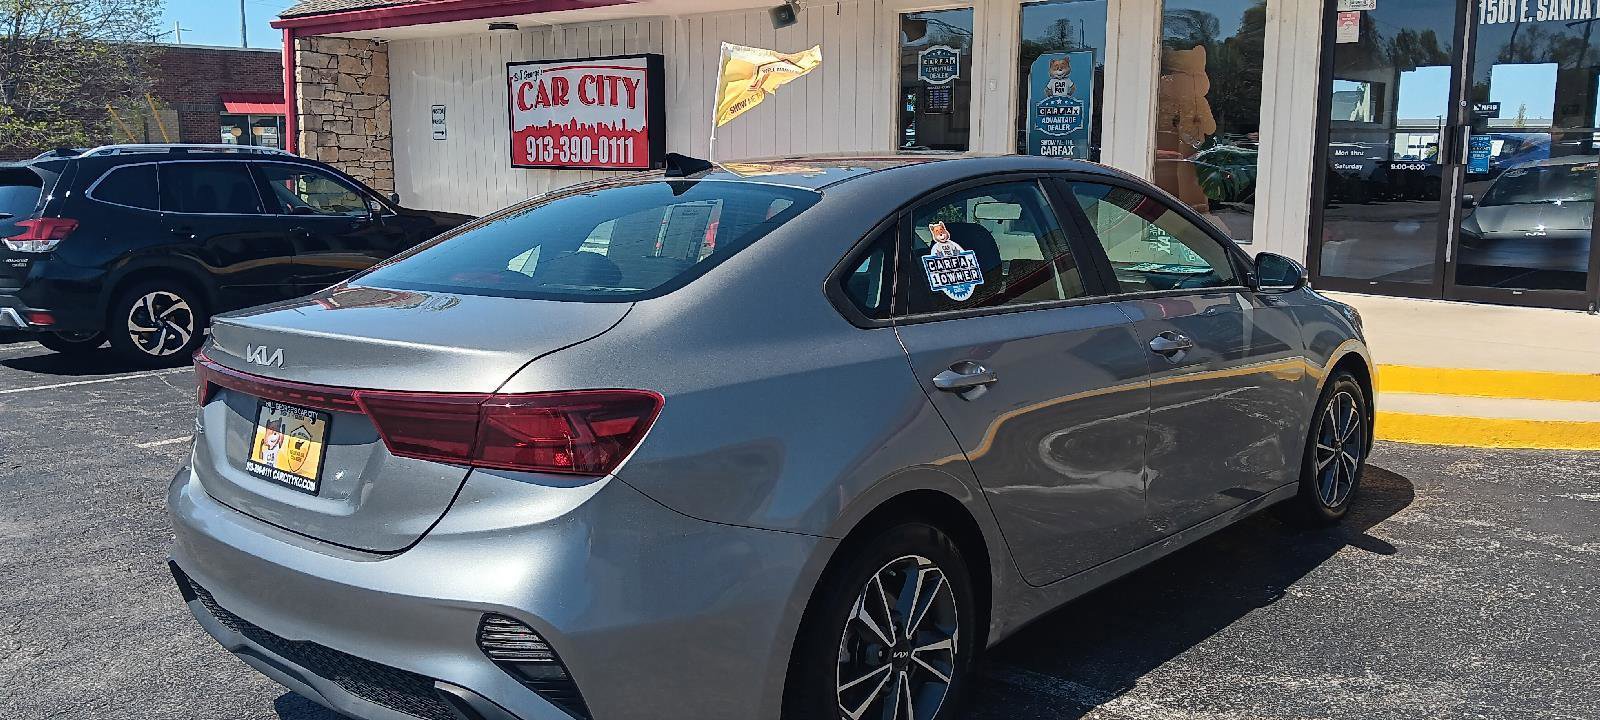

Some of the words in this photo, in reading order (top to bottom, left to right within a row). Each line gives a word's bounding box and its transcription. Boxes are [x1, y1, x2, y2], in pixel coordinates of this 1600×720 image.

[1479, 0, 1516, 24] 1501
[1536, 0, 1592, 22] SANTA
[517, 76, 570, 112] CAR
[577, 74, 641, 110] CITY
[1039, 106, 1080, 116] CARFAX
[1041, 116, 1077, 124] ADVANTAGE
[1047, 124, 1071, 132] DEALER
[526, 134, 634, 164] 913-390-0111
[1040, 145, 1076, 156] CARFAX
[1334, 163, 1363, 171] Saturday
[1390, 163, 1426, 171] 9:00-6:00
[928, 256, 976, 271] CARFAX
[246, 343, 285, 369] KIA
